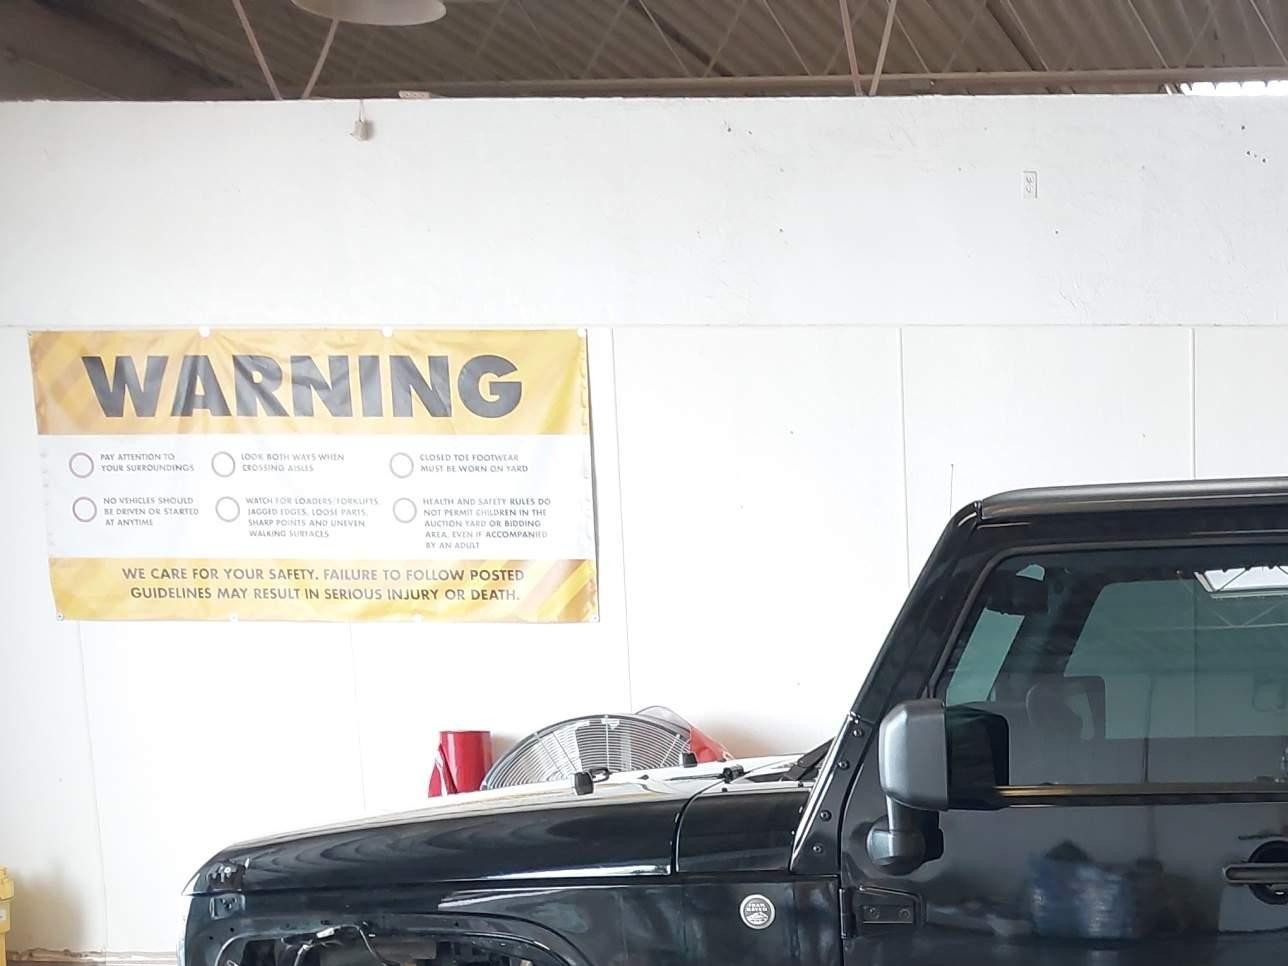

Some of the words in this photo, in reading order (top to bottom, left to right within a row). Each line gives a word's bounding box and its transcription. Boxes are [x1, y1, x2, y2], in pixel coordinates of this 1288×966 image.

[81, 353, 523, 420] WARNING
[100, 453, 115, 461] PAY
[118, 453, 161, 461] ATTENTION
[164, 453, 175, 461] TO
[241, 453, 263, 461] LOOK
[266, 453, 290, 461] BOTH
[293, 453, 316, 461] WAYS
[318, 453, 345, 461] WHEN
[420, 454, 451, 462] CLOSED
[454, 454, 469, 462] TOE
[472, 454, 519, 462] FOOTWEAR
[101, 464, 124, 472] YOUR
[127, 464, 195, 472] SURROUNDINGS
[242, 464, 285, 472] CROSSING
[288, 464, 314, 472] AISLES
[421, 465, 443, 473] MUST
[447, 465, 456, 473] BE
[459, 465, 487, 473] WORN
[490, 465, 503, 473] ON
[506, 465, 528, 473] YARD
[103, 497, 117, 505] NO
[119, 497, 155, 505] VEHICLES
[158, 497, 194, 505] SHOULD
[423, 498, 454, 506] HEALTH
[457, 498, 476, 506] AND
[478, 498, 506, 506] SAFETY
[510, 498, 535, 506] RULES
[538, 498, 551, 506] DO
[104, 508, 113, 516] BE
[116, 508, 146, 516] DRIVEN
[148, 508, 160, 516] OR
[164, 508, 199, 516] STARTED
[248, 508, 278, 517] JAGGED
[312, 508, 337, 517] LOOSE
[424, 509, 441, 517] NOT
[444, 509, 473, 517] PERMIT
[476, 509, 517, 517] CHILDREN
[519, 509, 529, 517] IN
[532, 509, 546, 517] THE
[248, 519, 273, 527] SHARP
[276, 519, 306, 527] POINTS
[309, 519, 328, 527] AND
[331, 519, 366, 527] UNEVEN
[425, 520, 462, 528] AUCTION
[465, 520, 486, 528] YARD
[489, 520, 501, 528] OR
[504, 520, 541, 528] BIDDING
[249, 530, 286, 538] WALKING
[289, 530, 330, 538] SURFACES
[452, 531, 473, 539] EVEN
[476, 531, 482, 539] IF
[486, 531, 547, 539] ACCOMPANIED
[123, 568, 146, 581] WE
[151, 568, 188, 581] CARE
[193, 568, 219, 581] FOR
[224, 568, 264, 581] YOUR
[269, 568, 319, 581] SAFETY.
[324, 568, 378, 581] FAILURE
[384, 568, 402, 581] TO
[406, 568, 464, 581] FOLLOW
[470, 568, 525, 581] POSTED
[130, 587, 212, 600] GUIDELINES
[217, 587, 249, 600] MAY
[254, 587, 300, 600] RESULT
[305, 587, 320, 600] IN
[325, 587, 382, 600] SERIOUS
[388, 587, 439, 600] INJURY
[444, 587, 466, 600] OR
[471, 587, 521, 600] DEATH.
